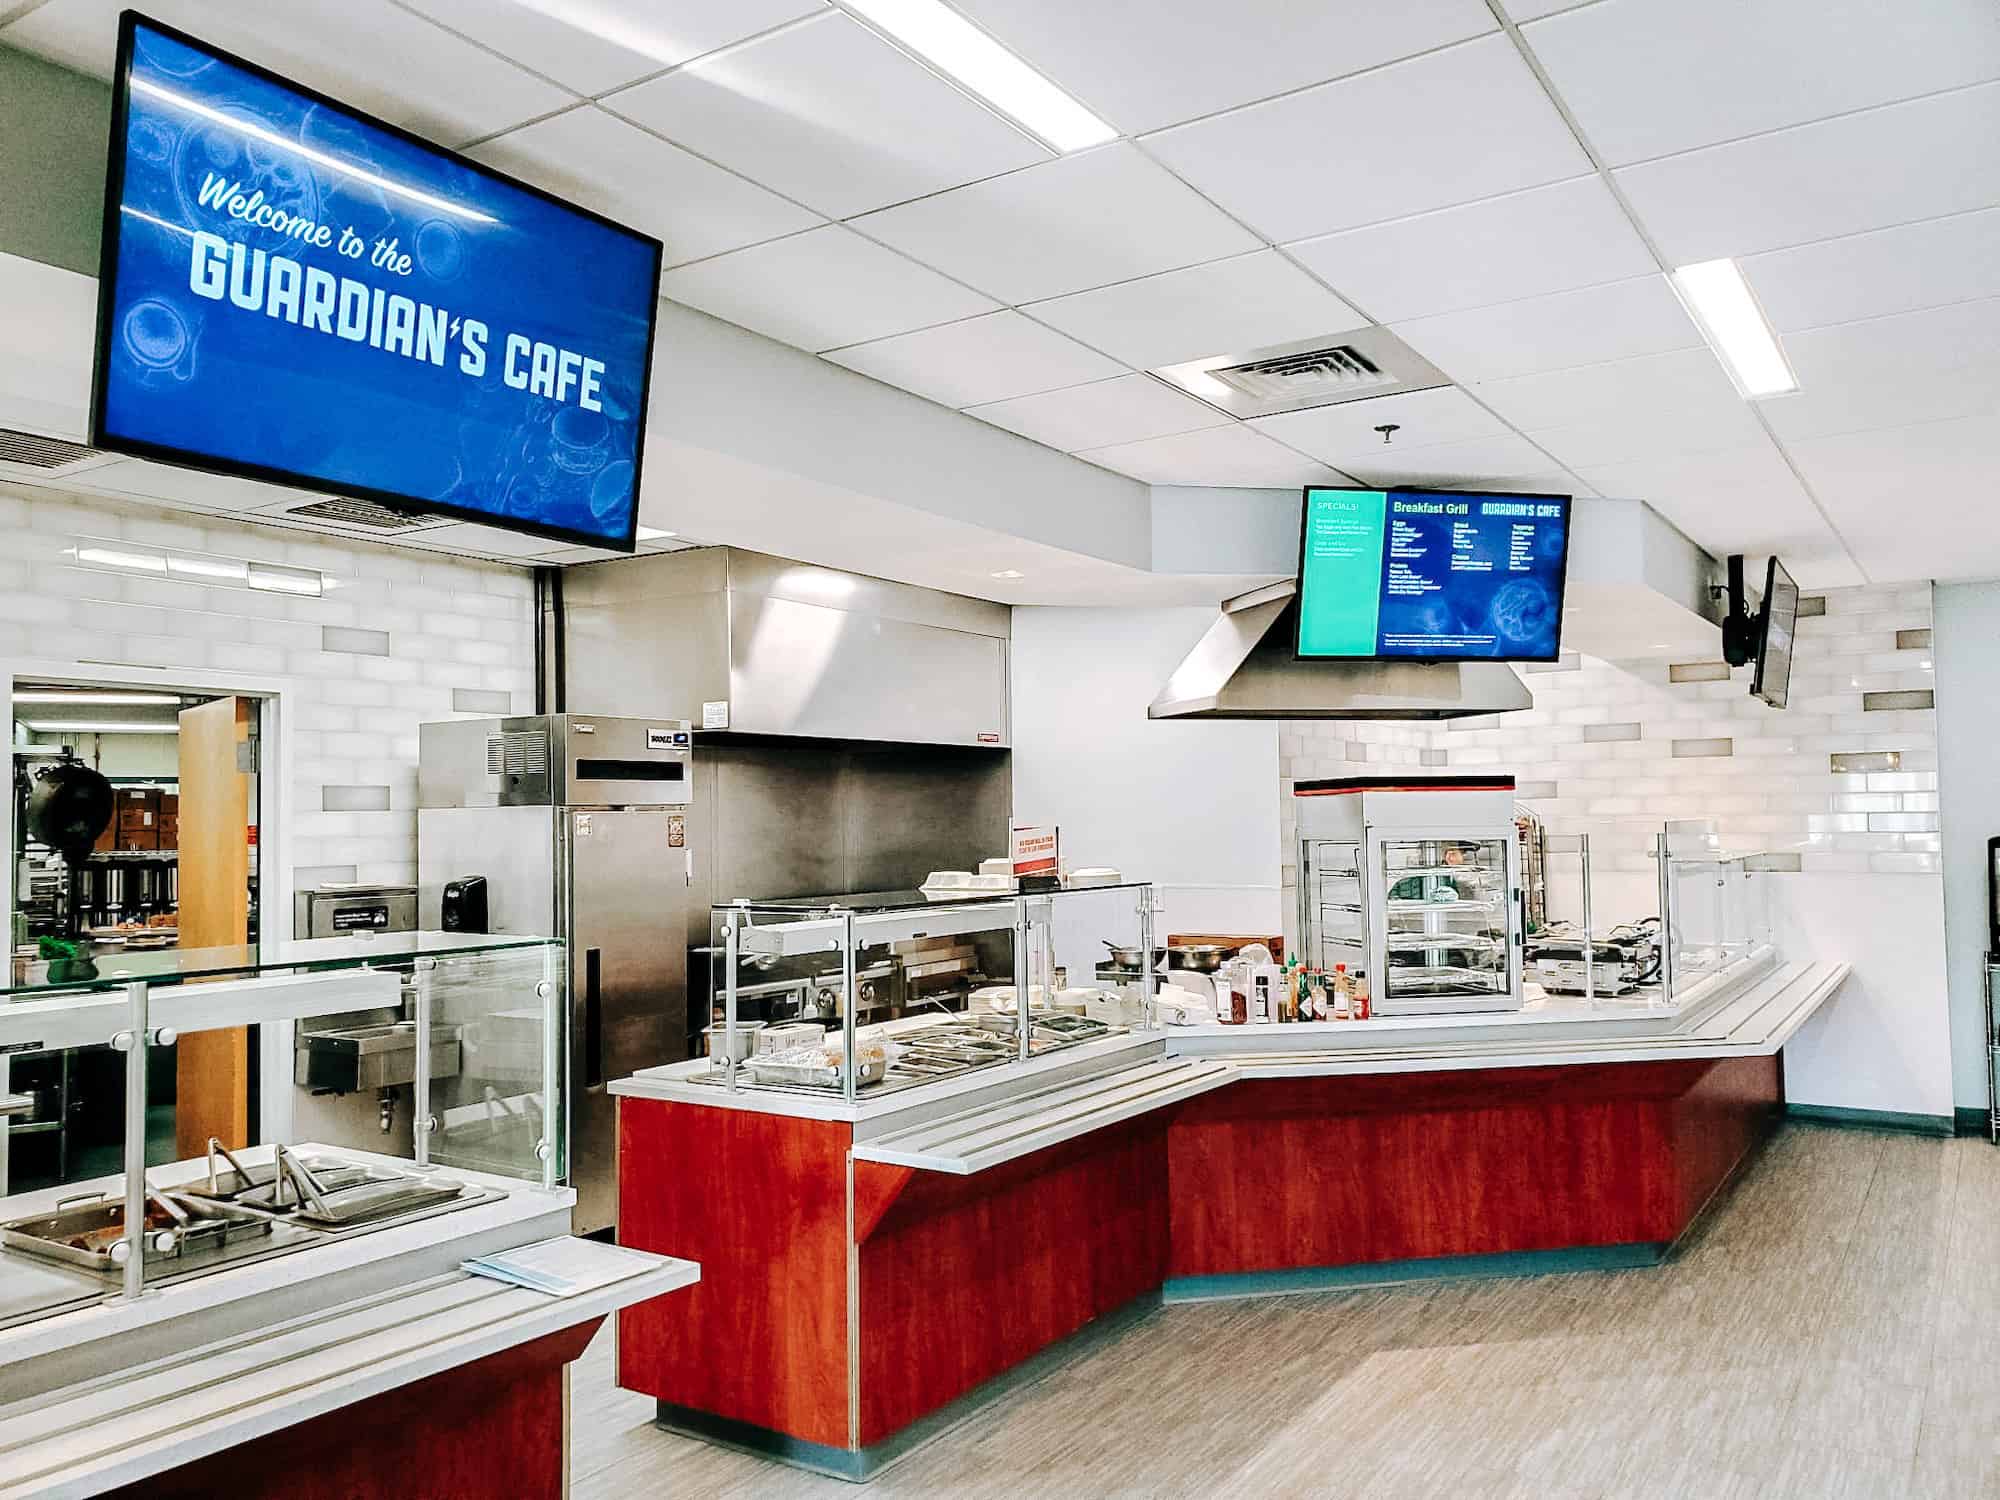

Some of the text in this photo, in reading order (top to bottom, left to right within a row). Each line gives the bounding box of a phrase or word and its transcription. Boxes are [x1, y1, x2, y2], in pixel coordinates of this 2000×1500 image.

[198, 172, 413, 276] Welcome to the
[189, 230, 606, 413] GUARDIAN'S CAFE
[1393, 501, 1469, 515] Breakfast Grill
[1537, 504, 1561, 517] CAFE
